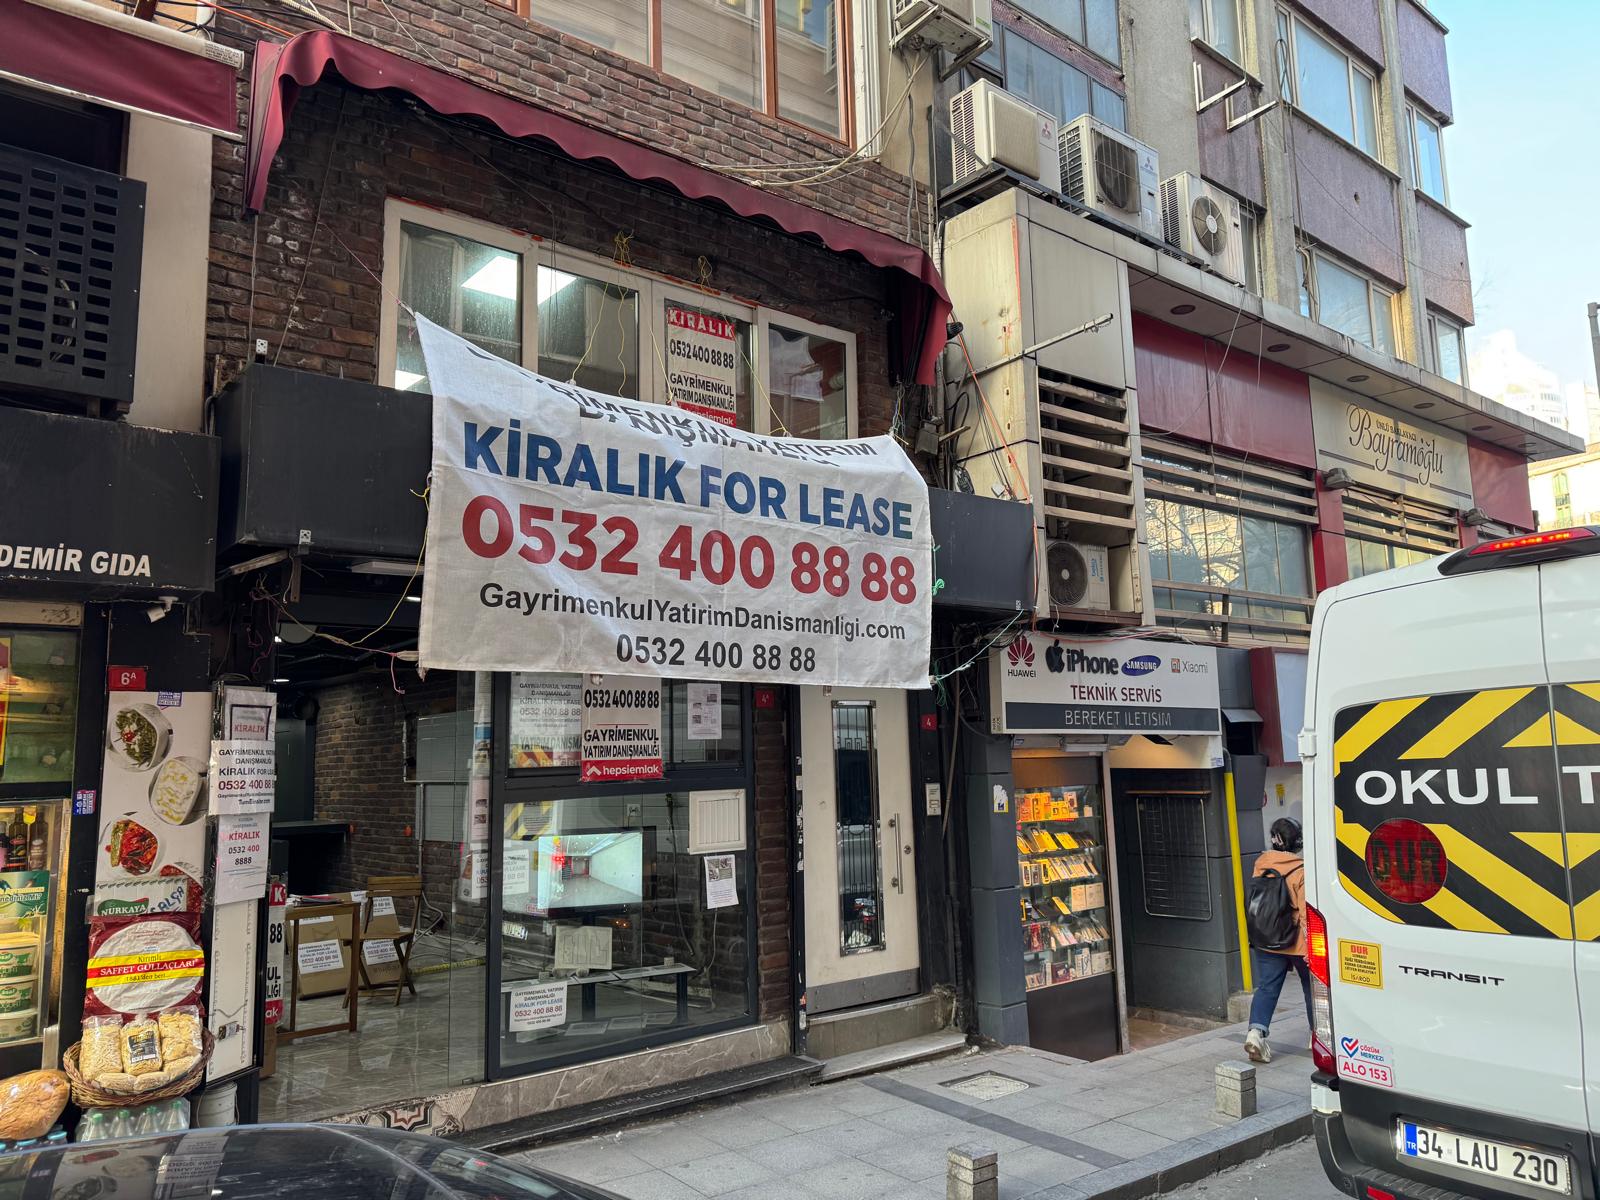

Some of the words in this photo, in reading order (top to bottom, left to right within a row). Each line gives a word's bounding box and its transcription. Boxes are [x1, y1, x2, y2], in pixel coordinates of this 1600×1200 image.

[670, 373, 734, 397] GAYRİMENKUL
[463, 419, 686, 504] KİRALIK
[700, 464, 788, 520] FOR
[799, 484, 913, 540] LEASE
[462, 494, 639, 576] 0532
[658, 524, 775, 590] 400
[790, 541, 850, 597] 88
[860, 551, 916, 605] 88
[0, 543, 82, 572] DEMİR
[91, 551, 151, 577] GIDA
[480, 582, 905, 642] GayrimenkulYatirimDanismanligi.com
[617, 634, 685, 666] 0532
[694, 640, 743, 669] 400
[752, 643, 781, 671] 88
[790, 646, 816, 673] 88
[1067, 648, 1119, 675] iPhone
[1126, 660, 1157, 671] SAMSUNG
[1182, 660, 1208, 673] Xiaomi
[1007, 669, 1037, 678] HUAWEI
[1070, 683, 1116, 701] TEKNİK
[1121, 685, 1162, 703] SERVİS
[1064, 710, 1120, 726] BEREKET
[584, 725, 659, 742] GAYRİMENKUL
[583, 745, 611, 758] YATIRIM
[613, 743, 660, 759] DANIŞMANLIĞI
[219, 767, 255, 776] KİRALIK
[603, 764, 659, 776] hepsiemlak
[219, 780, 246, 790] 0532
[249, 780, 263, 789] 400
[1355, 767, 1539, 806] OKUL
[228, 831, 260, 841] KİRALIK
[228, 846, 246, 854] 0532
[235, 857, 252, 865] 8888
[1371, 839, 1441, 884] DUR
[101, 904, 146, 916] NURKAYA
[1350, 945, 1369, 955] DUR
[100, 966, 136, 976] SAFFET
[1398, 965, 1504, 986] TRANSIT
[1359, 1045, 1380, 1054] ÇÖZÜM
[1343, 1061, 1366, 1076] ALO
[1369, 1067, 1388, 1081] 153
[1406, 1141, 1416, 1150] TR
[1417, 1130, 1443, 1158] 34
[1455, 1138, 1498, 1172] LAU
[1512, 1151, 1558, 1186] 230
